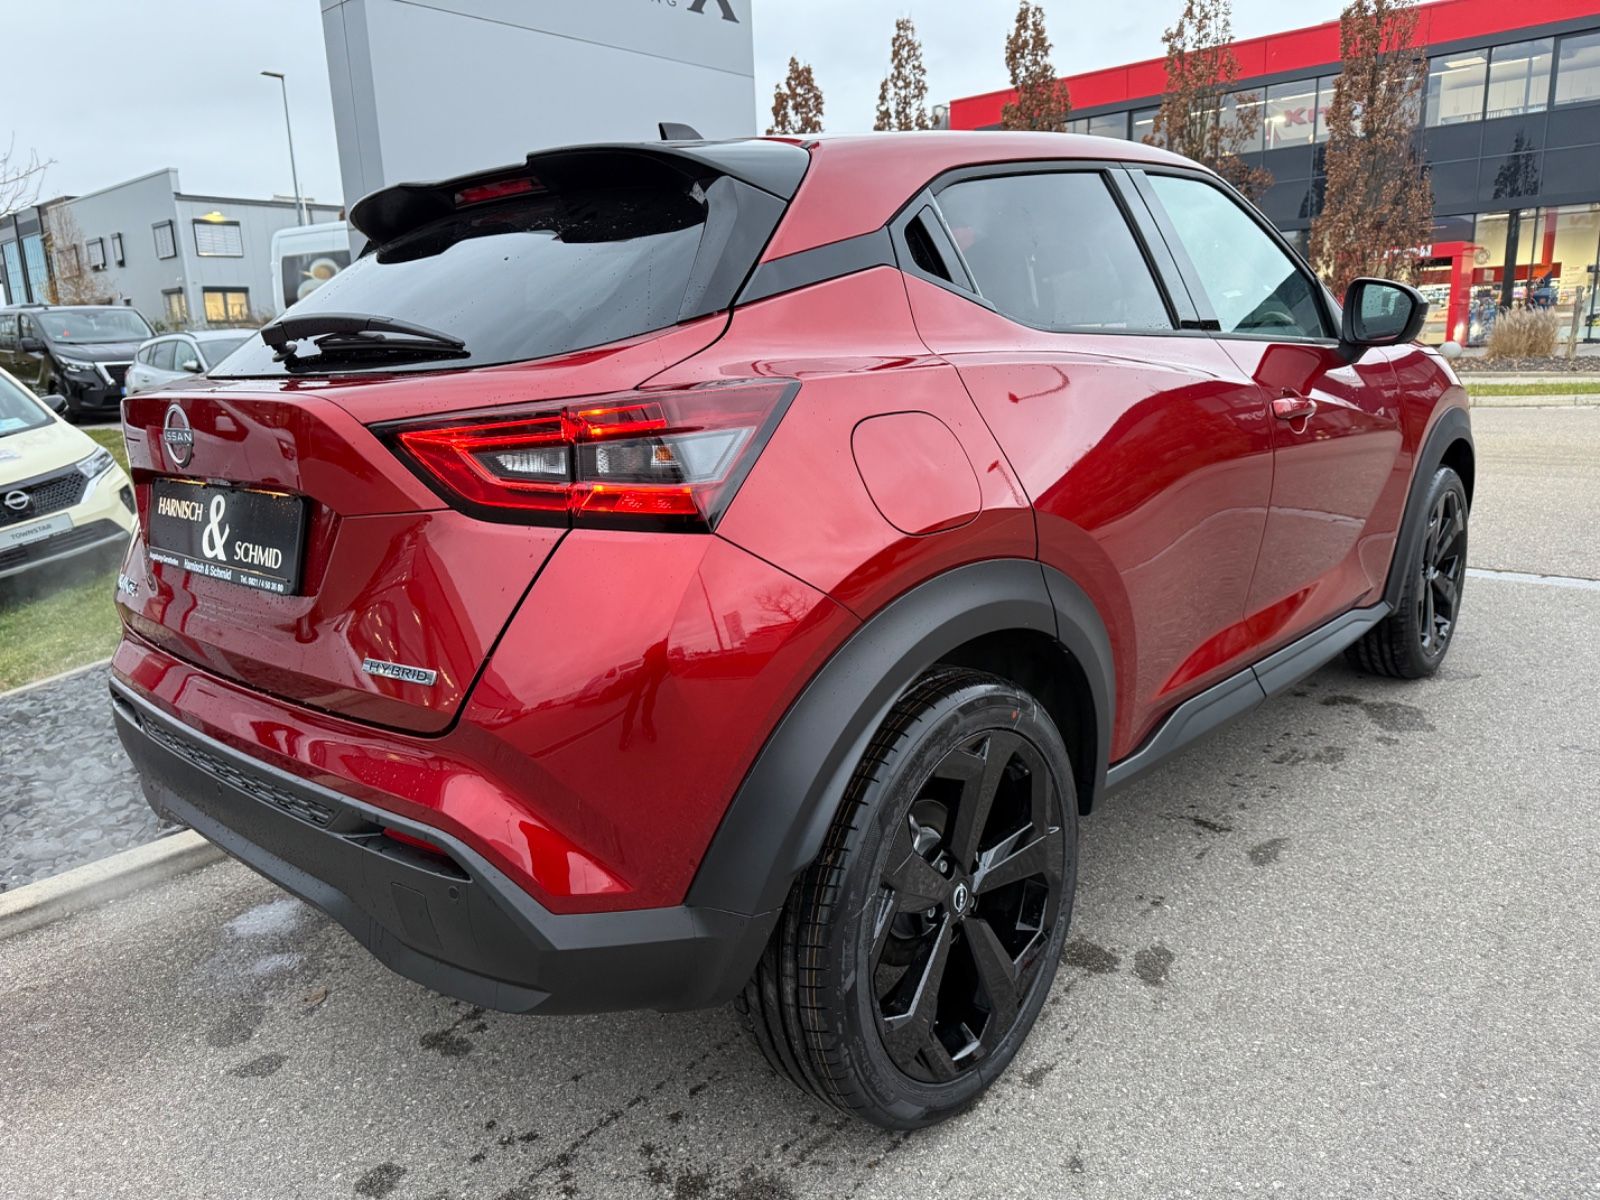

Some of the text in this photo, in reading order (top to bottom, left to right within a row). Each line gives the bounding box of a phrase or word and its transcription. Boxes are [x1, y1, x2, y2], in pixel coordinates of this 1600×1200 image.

[11, 523, 52, 540] TOWNSTAR
[157, 496, 204, 522] HARNISCH
[202, 494, 231, 562] &
[233, 540, 282, 570] SCHMID
[210, 564, 232, 580] Schmid
[369, 662, 428, 681] HYBRID
